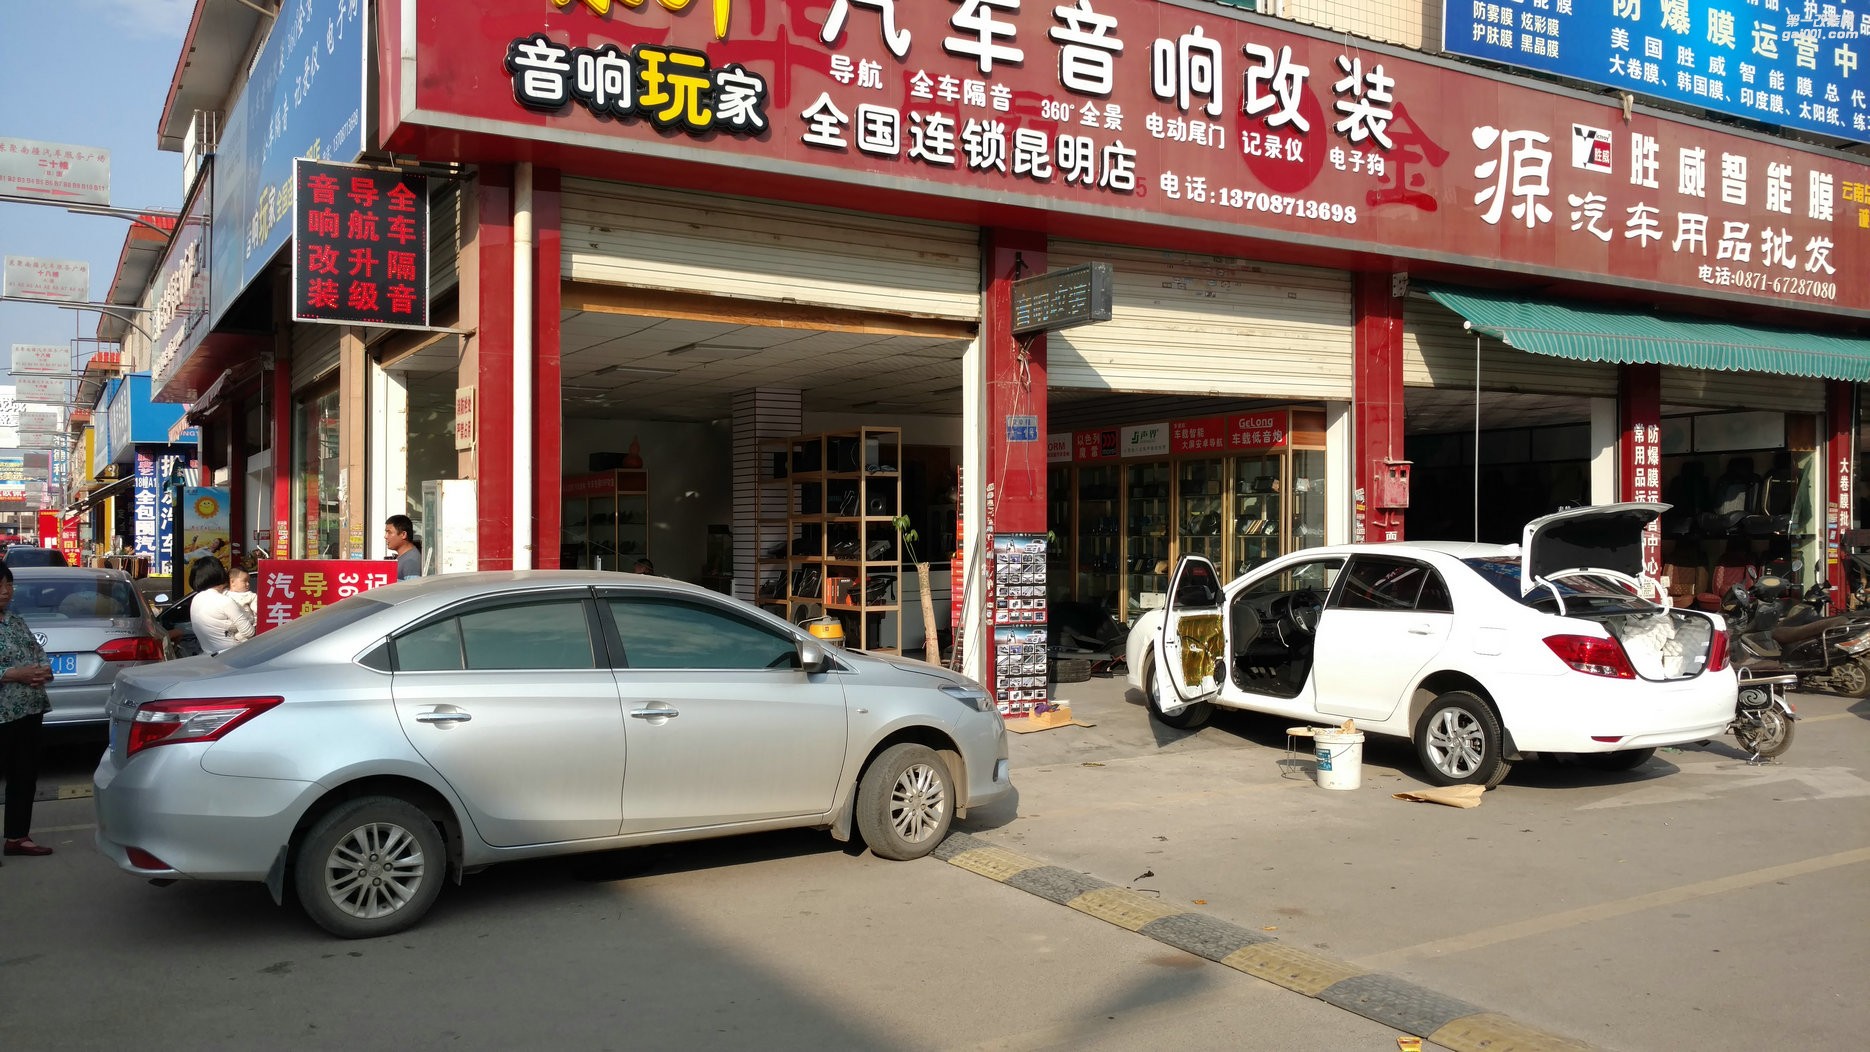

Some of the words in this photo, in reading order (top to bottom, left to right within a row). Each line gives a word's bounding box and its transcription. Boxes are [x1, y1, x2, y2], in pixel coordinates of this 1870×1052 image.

[1472, 22, 1513, 49] 护肤膜
[1520, 33, 1560, 59] 黑晶膜
[1473, 0, 1513, 27] 防雾膜
[1520, 11, 1560, 38] 炫彩膜
[515, 38, 764, 128] 音响玩家
[1609, 54, 1870, 132] 大卷膜、韩国膜、印度膜、太阳纸、练
[1610, 27, 1866, 110] 美国胜威智能膜总代
[801, 91, 1137, 191] 全国连锁昆明店
[829, 54, 883, 90] 导航
[910, 69, 1013, 112] 全车隔音
[1146, 112, 1225, 150] 电动尾门
[1242, 130, 1304, 163] 记录仪
[1329, 145, 1385, 177] 电子狗
[1471, 125, 1553, 229] 源
[1630, 131, 1834, 222] 胜威智能膜
[307, 173, 341, 310] 音响改装
[347, 176, 380, 312] 导航升级
[386, 181, 417, 315] 全车隔音
[1567, 191, 1837, 275] 汽车用品批发
[1698, 264, 1837, 301] 电话:0871-67287080
[1232, 429, 1283, 446] 车载低音炮
[1839, 457, 1850, 534] 大卷膜批
